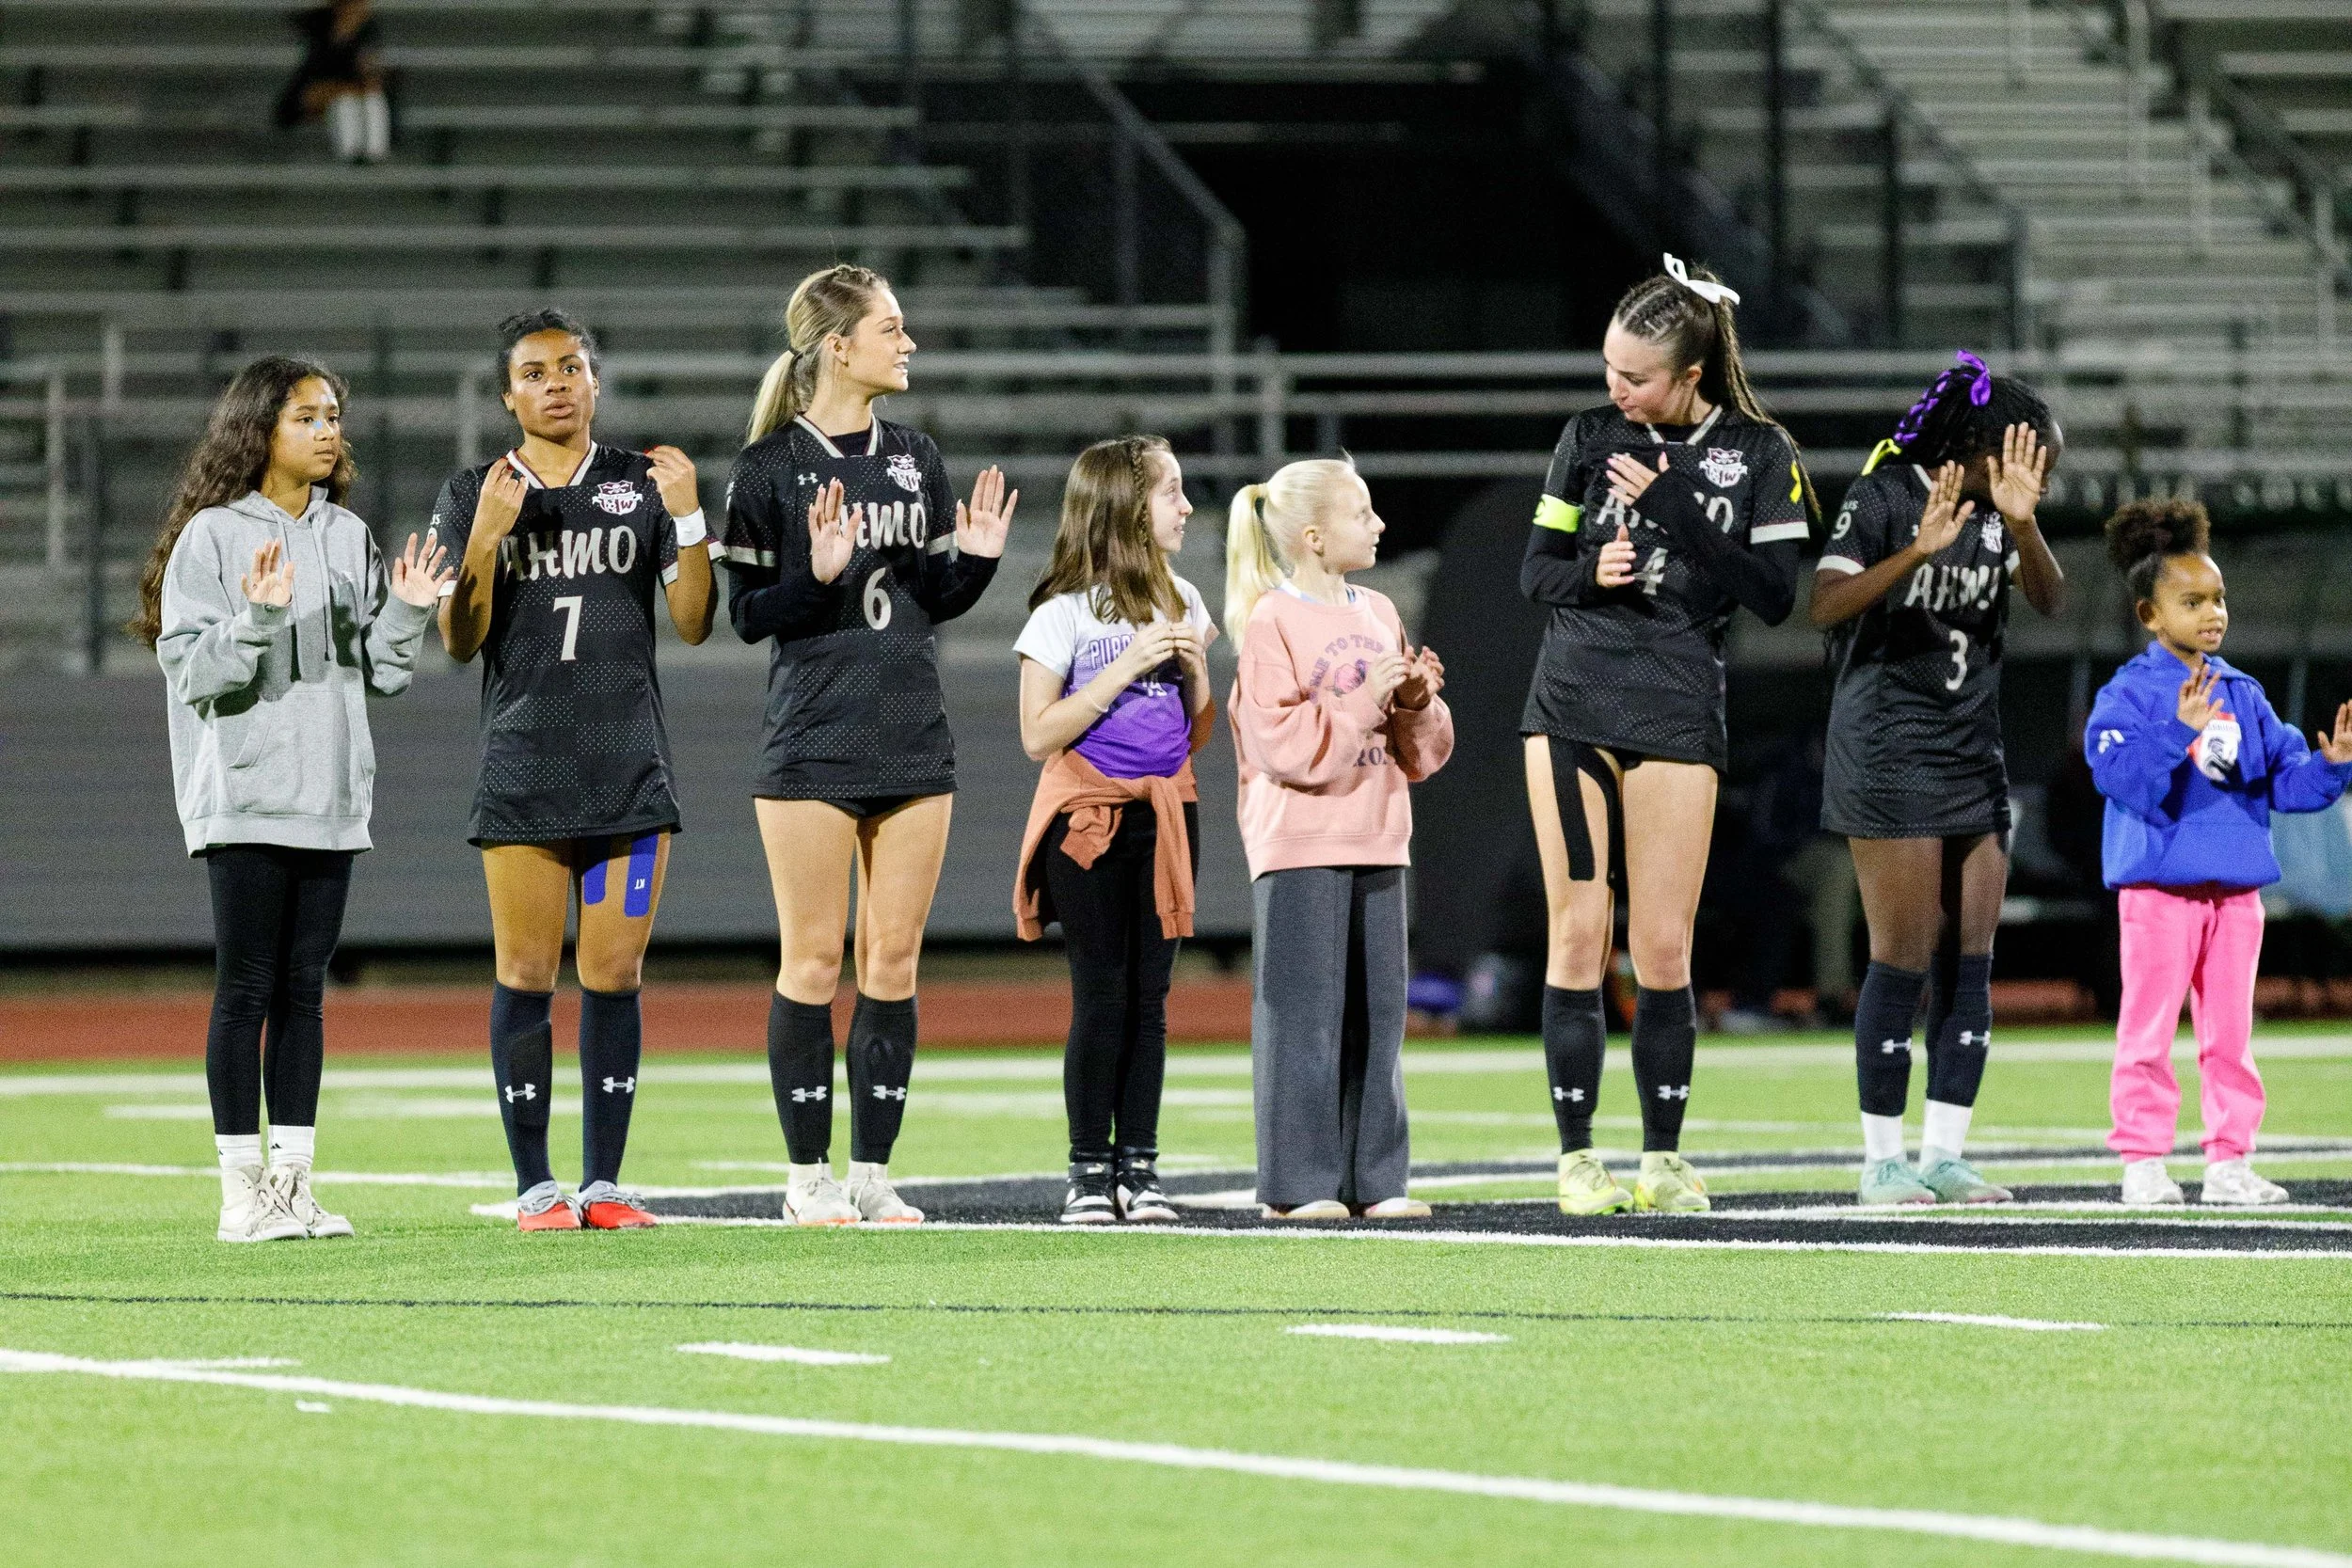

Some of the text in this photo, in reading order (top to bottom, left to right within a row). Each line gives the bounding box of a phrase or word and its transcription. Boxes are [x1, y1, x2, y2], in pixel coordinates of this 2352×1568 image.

[1831, 511, 1852, 541] 9
[863, 567, 892, 630] 6
[1633, 546, 1668, 595] 4
[552, 595, 583, 661] 7
[1945, 629, 1968, 690] 3
